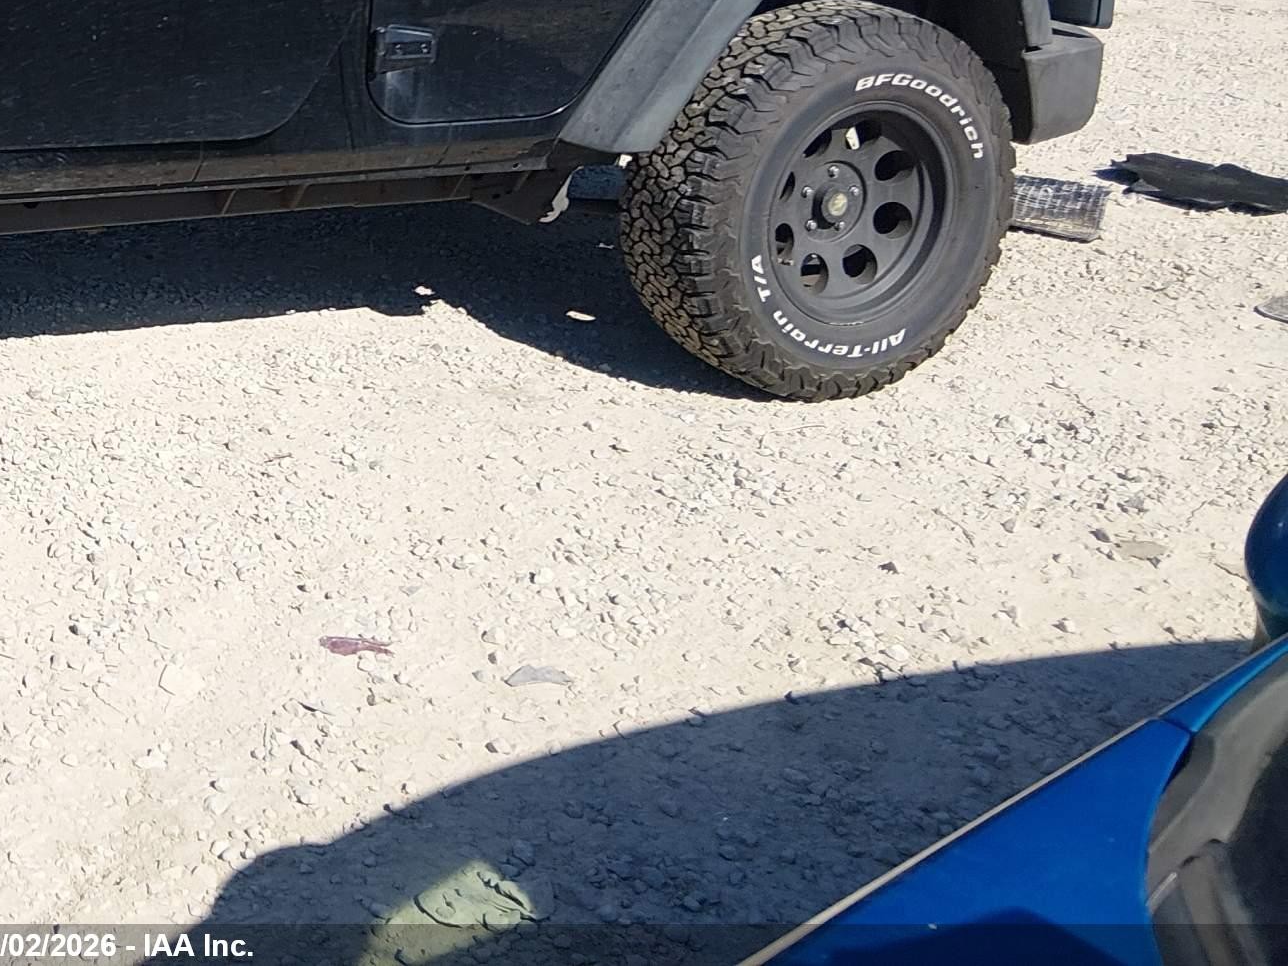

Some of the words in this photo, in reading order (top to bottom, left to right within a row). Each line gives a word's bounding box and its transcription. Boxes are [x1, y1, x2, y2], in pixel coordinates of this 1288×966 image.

[855, 73, 984, 159] BFGoodrich
[751, 254, 769, 303] T/A
[772, 309, 907, 358] All-Terrain
